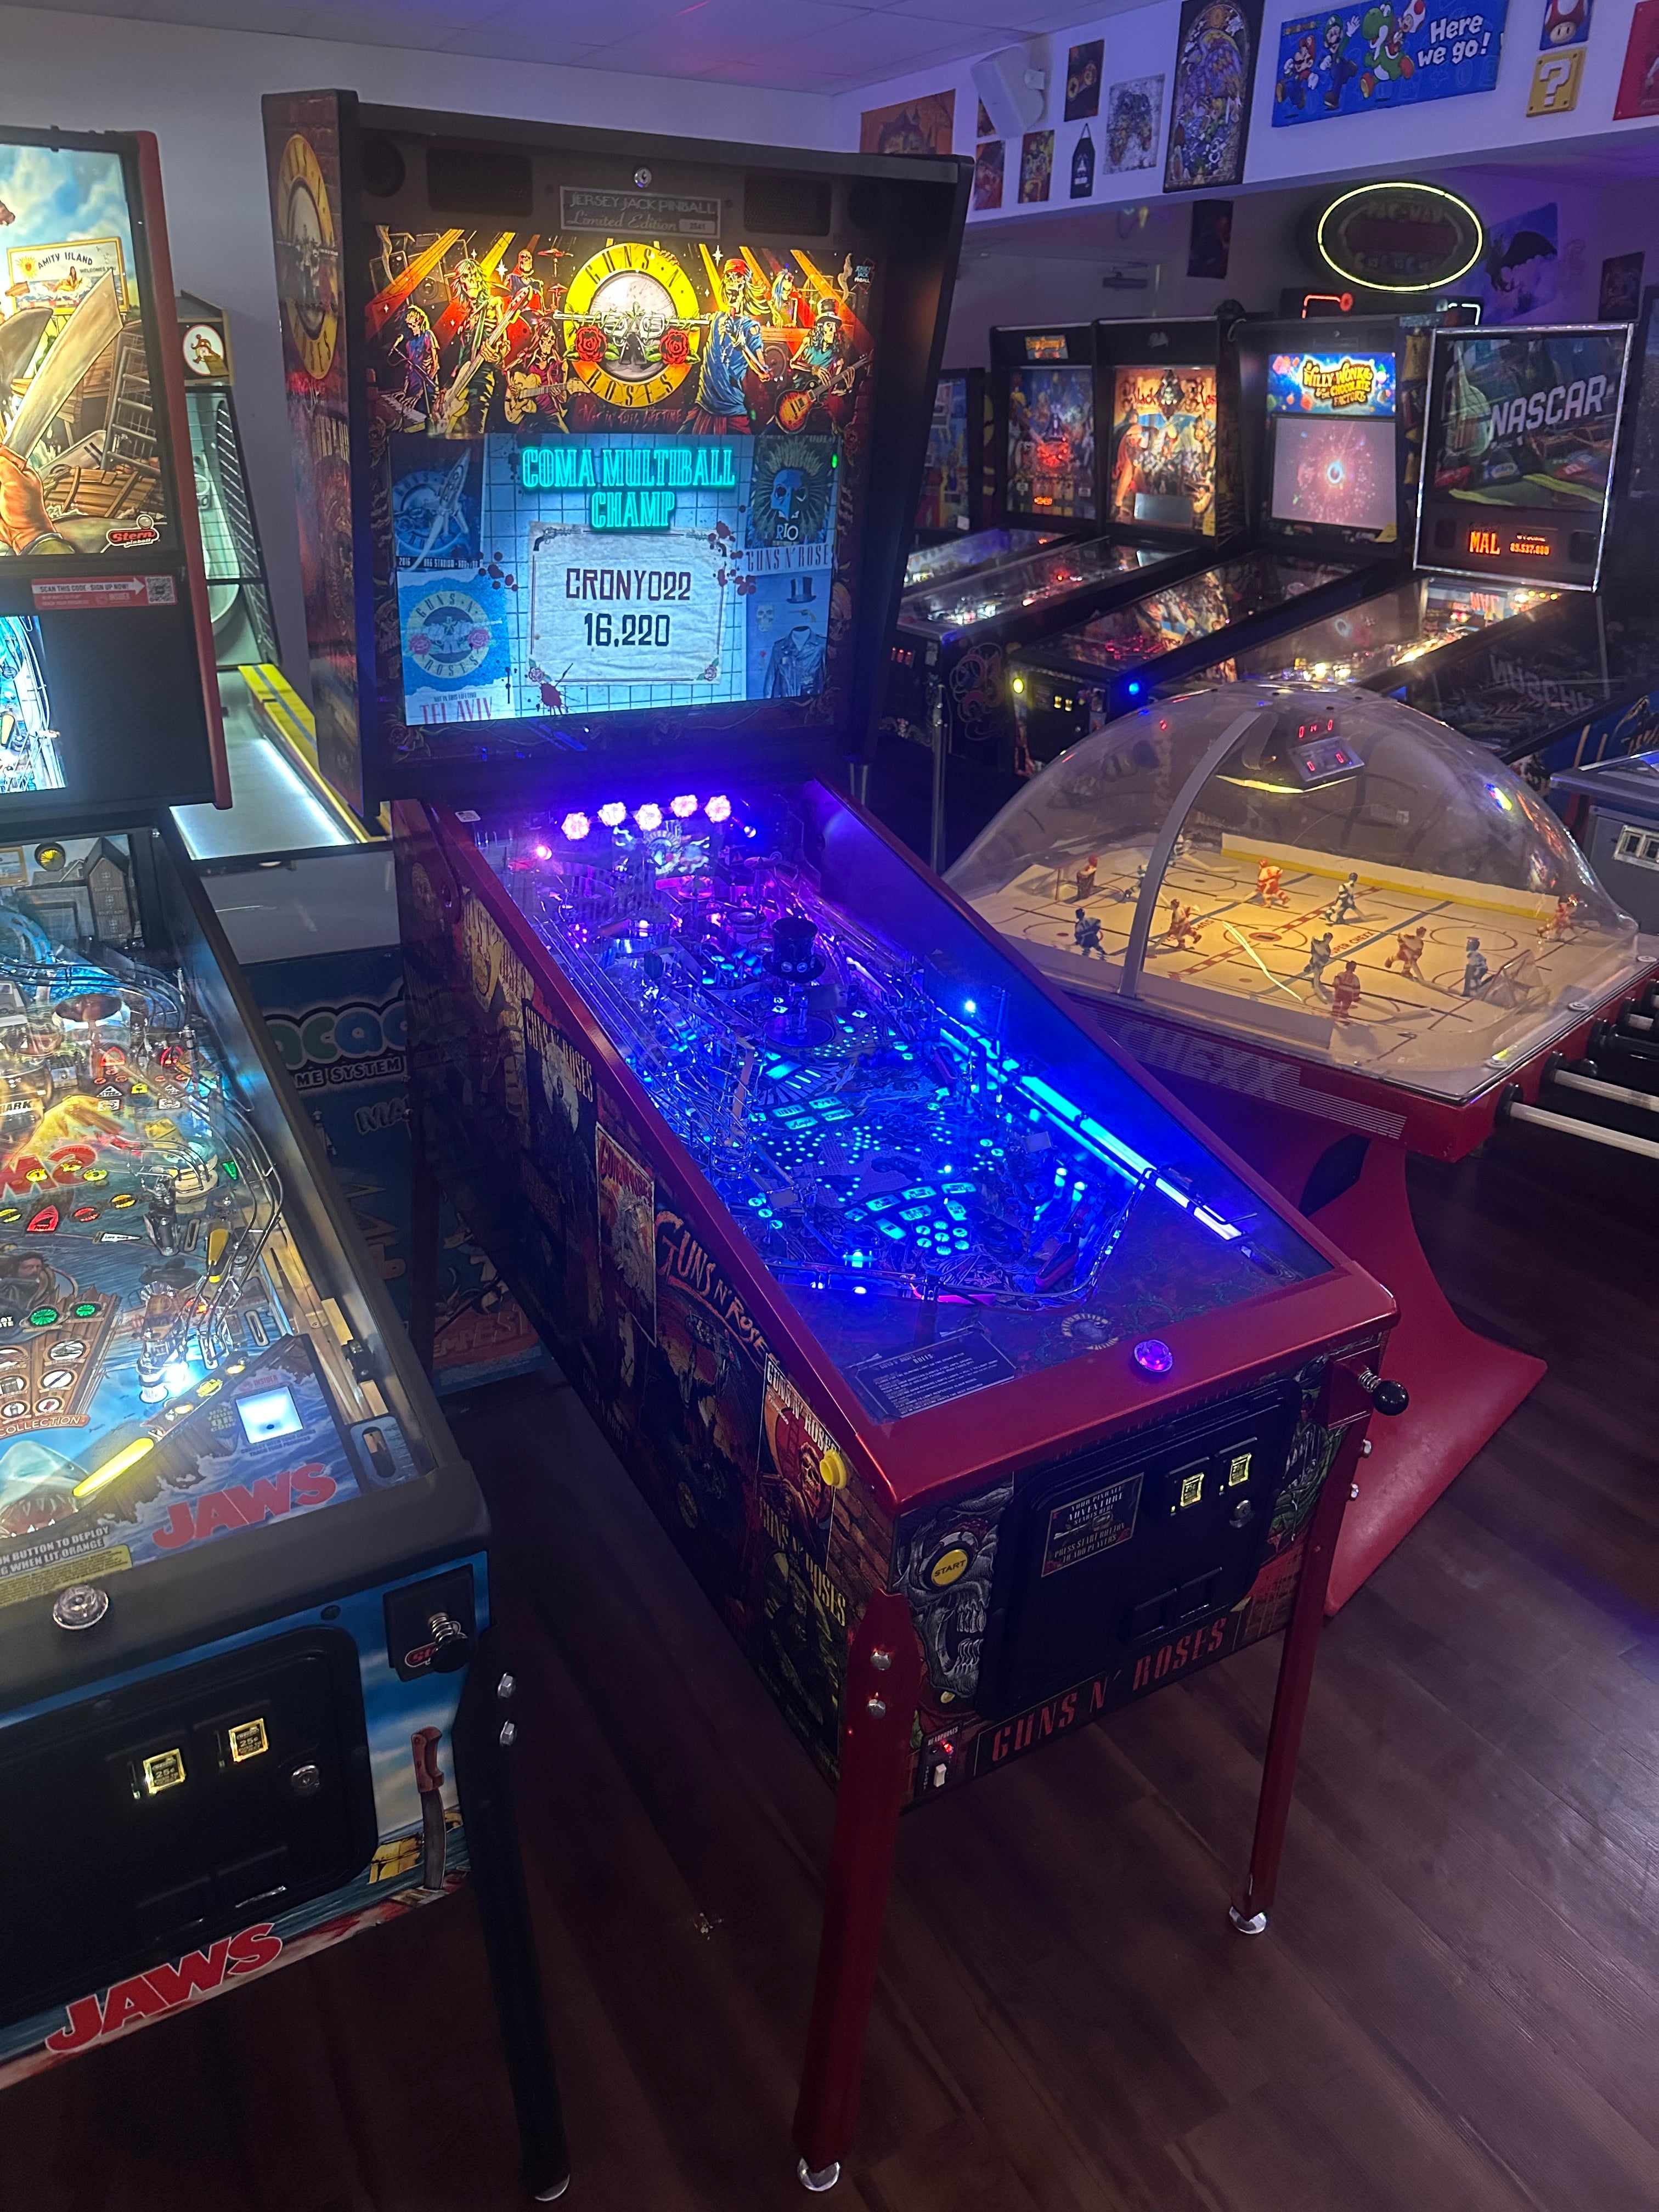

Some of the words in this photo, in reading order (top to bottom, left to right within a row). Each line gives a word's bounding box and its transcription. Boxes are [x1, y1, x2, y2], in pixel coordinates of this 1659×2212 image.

[1430, 15, 1483, 44] Here
[1418, 47, 1446, 67] we
[1452, 32, 1491, 64] go!
[570, 194, 619, 207] JERSEY
[621, 198, 657, 211] JACK
[658, 200, 715, 215] PINBALL
[567, 210, 623, 227] Limited
[628, 213, 678, 231] Edition
[38, 253, 60, 269] AMITY
[65, 252, 93, 266] ISLAND
[585, 245, 651, 285] GUNS
[586, 368, 674, 407] ROSES
[1304, 363, 1335, 387] WILLY
[1335, 363, 1373, 384] WONKA
[1330, 380, 1371, 397] CHOCOLATE
[1492, 375, 1607, 436] NASCAR
[522, 448, 596, 488] COMA
[602, 448, 735, 487] MULTIBALL
[591, 491, 675, 528] CHAMP
[112, 531, 153, 542] Stern
[125, 538, 151, 546] pinball
[776, 523, 799, 541] RIO
[1470, 531, 1500, 555] MAL
[746, 549, 780, 572] GUNS
[114, 582, 129, 590] NOW!
[416, 593, 455, 618] GUNS
[424, 654, 479, 677] ROSES
[457, 697, 493, 723] AVIV
[1349, 930, 1376, 945] CHEXX
[295, 1071, 323, 1090] ME
[330, 1057, 401, 1082] SYSTEM
[0, 1100, 32, 1114] HARK
[654, 1210, 716, 1297] GUNS
[433, 1304, 529, 1358] EMPEST
[253, 1375, 278, 1386] INSIDER
[767, 1359, 791, 1409] GUNS
[0, 1416, 81, 1437] COLLECTION
[151, 1462, 337, 1550] JAWS
[1069, 1492, 1124, 1521] ADVENTURE
[1093, 1486, 1122, 1502] PINBALL
[12, 1541, 54, 1561] BUTTON
[56, 1537, 70, 1548] TO
[71, 1526, 110, 1543] DEPLOY
[1077, 1533, 1098, 1548] START
[1099, 1522, 1125, 1539] BUTTON
[10, 1556, 43, 1572] WHEN
[44, 1551, 60, 1563] LIT
[61, 1538, 104, 1559] ORANGE
[934, 1560, 966, 1577] START
[805, 1552, 846, 1627] ROSES
[992, 1692, 1078, 1762] GUNS
[1090, 1669, 1122, 1713] N'
[1132, 1617, 1227, 1691] ROSES
[928, 1726, 959, 1746] HEADPHONES
[45, 1921, 283, 2055] JAWS
